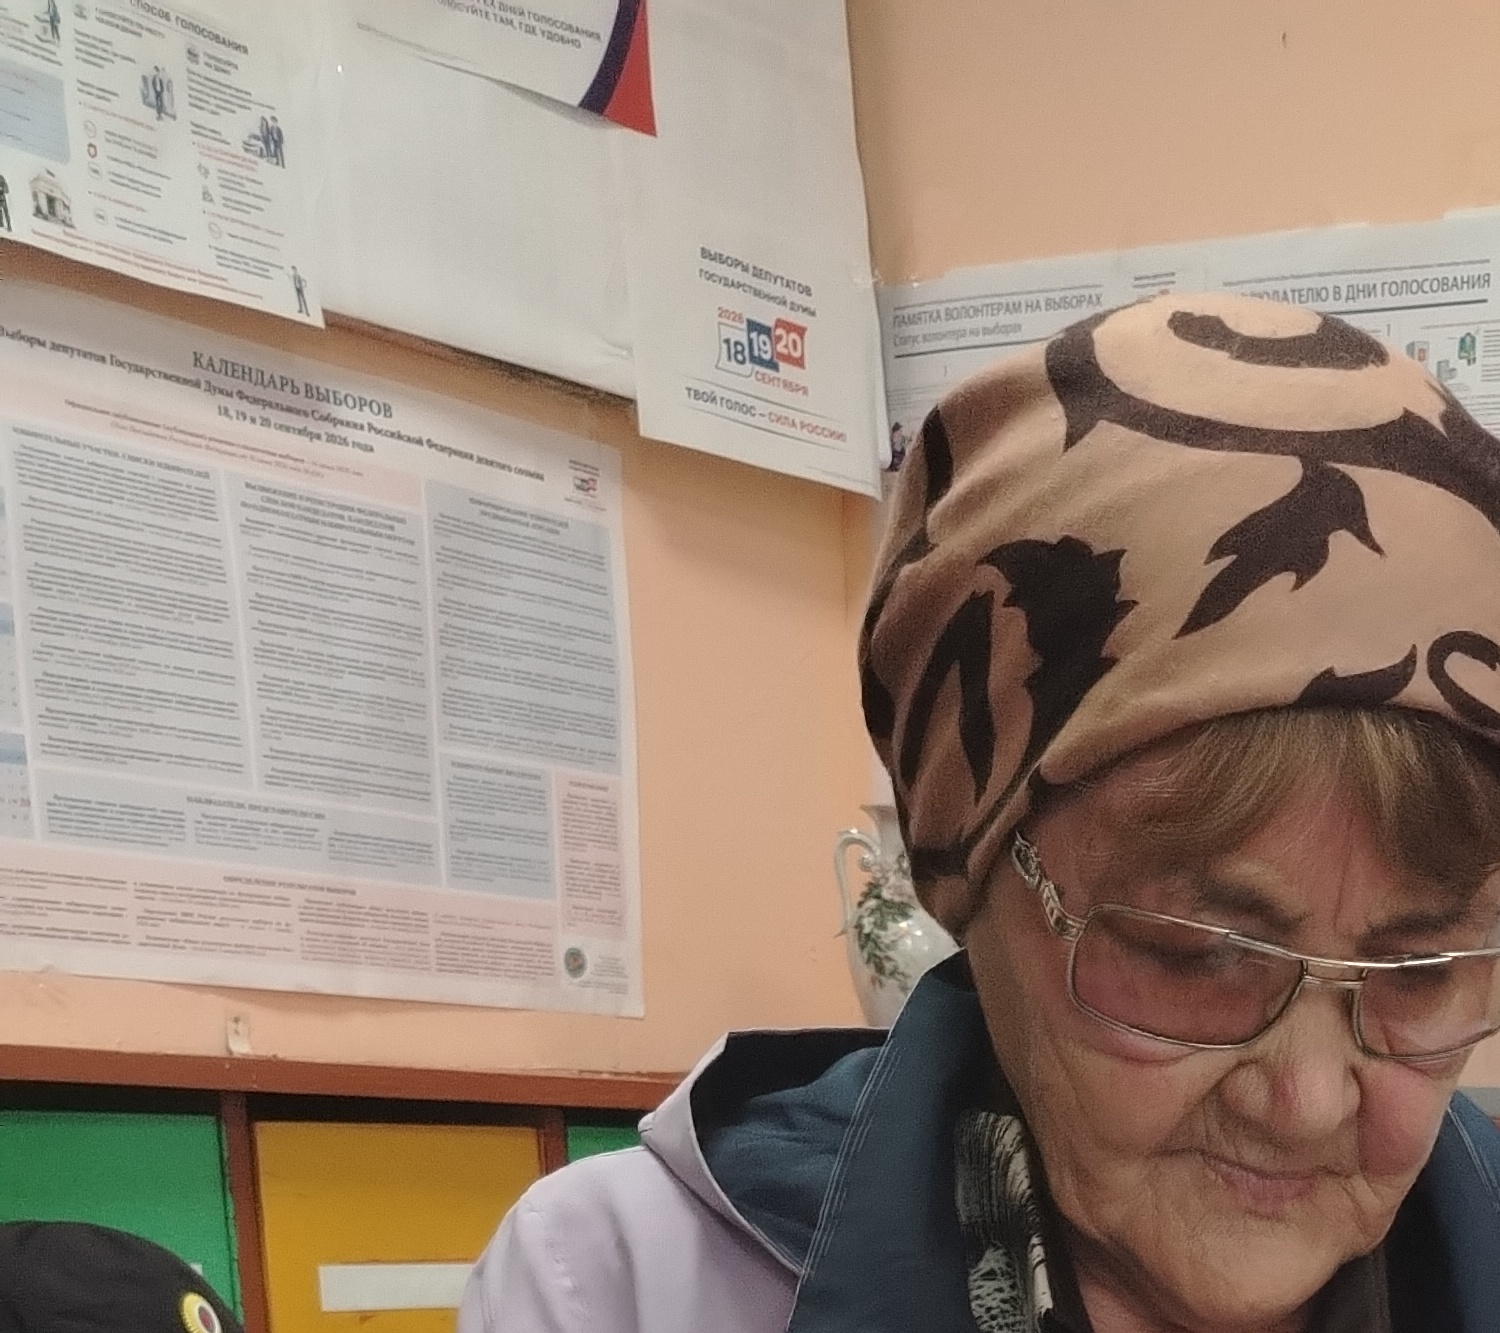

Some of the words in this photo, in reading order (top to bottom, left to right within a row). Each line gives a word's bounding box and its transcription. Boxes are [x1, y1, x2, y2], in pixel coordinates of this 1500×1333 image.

[175, 16, 249, 55] ГОЛОСОВАНИЯ
[492, 13, 517, 30] ТАМ,
[518, 21, 538, 37] ГДЕ
[539, 28, 581, 49] УДОБНО
[498, 2, 525, 17] ДНЕЙ
[527, 11, 601, 41] ГОЛОСОВАНИЯ
[700, 247, 750, 274] ВЫБОРЫ
[752, 265, 813, 297] ДЕПУТАТОВ
[1332, 285, 1342, 302] В
[1345, 282, 1377, 302] ДНИ
[1380, 273, 1492, 298] ГОЛОСОВАНИЯ
[699, 268, 788, 309] ГОСУДАРСТВЕННОЙ
[789, 300, 816, 318] ДУМЫ
[893, 308, 942, 328] ПАМЯТКА
[944, 300, 1022, 322] ВОЛОНТЕРАМ
[1024, 298, 1043, 315] НА
[1044, 292, 1104, 312] ВЫБОРАХ
[749, 332, 772, 362] 19
[775, 327, 803, 358] 20
[982, 321, 1023, 338] выборах
[722, 337, 747, 366] 18
[49, 341, 106, 365] депутатов
[109, 353, 201, 389] Государственной
[203, 380, 234, 398] Думы
[236, 388, 310, 418] Федерального
[311, 408, 365, 432] Собрания
[367, 421, 424, 447] Российской
[426, 437, 474, 461] Федерации
[192, 351, 301, 397] КАЛЕНДАРЬ
[304, 382, 394, 420] ВЫБОРОВ
[754, 370, 810, 397] СЕНТЯБРЯ
[685, 386, 718, 406] ТВОЙ
[718, 397, 757, 418] ГОЛОС
[768, 411, 797, 429] СИЛА
[217, 404, 233, 421] 18,
[235, 408, 247, 422] 19
[259, 415, 272, 428] 20
[273, 421, 322, 443] сентября
[325, 432, 350, 448] 2026
[351, 441, 375, 454] года
